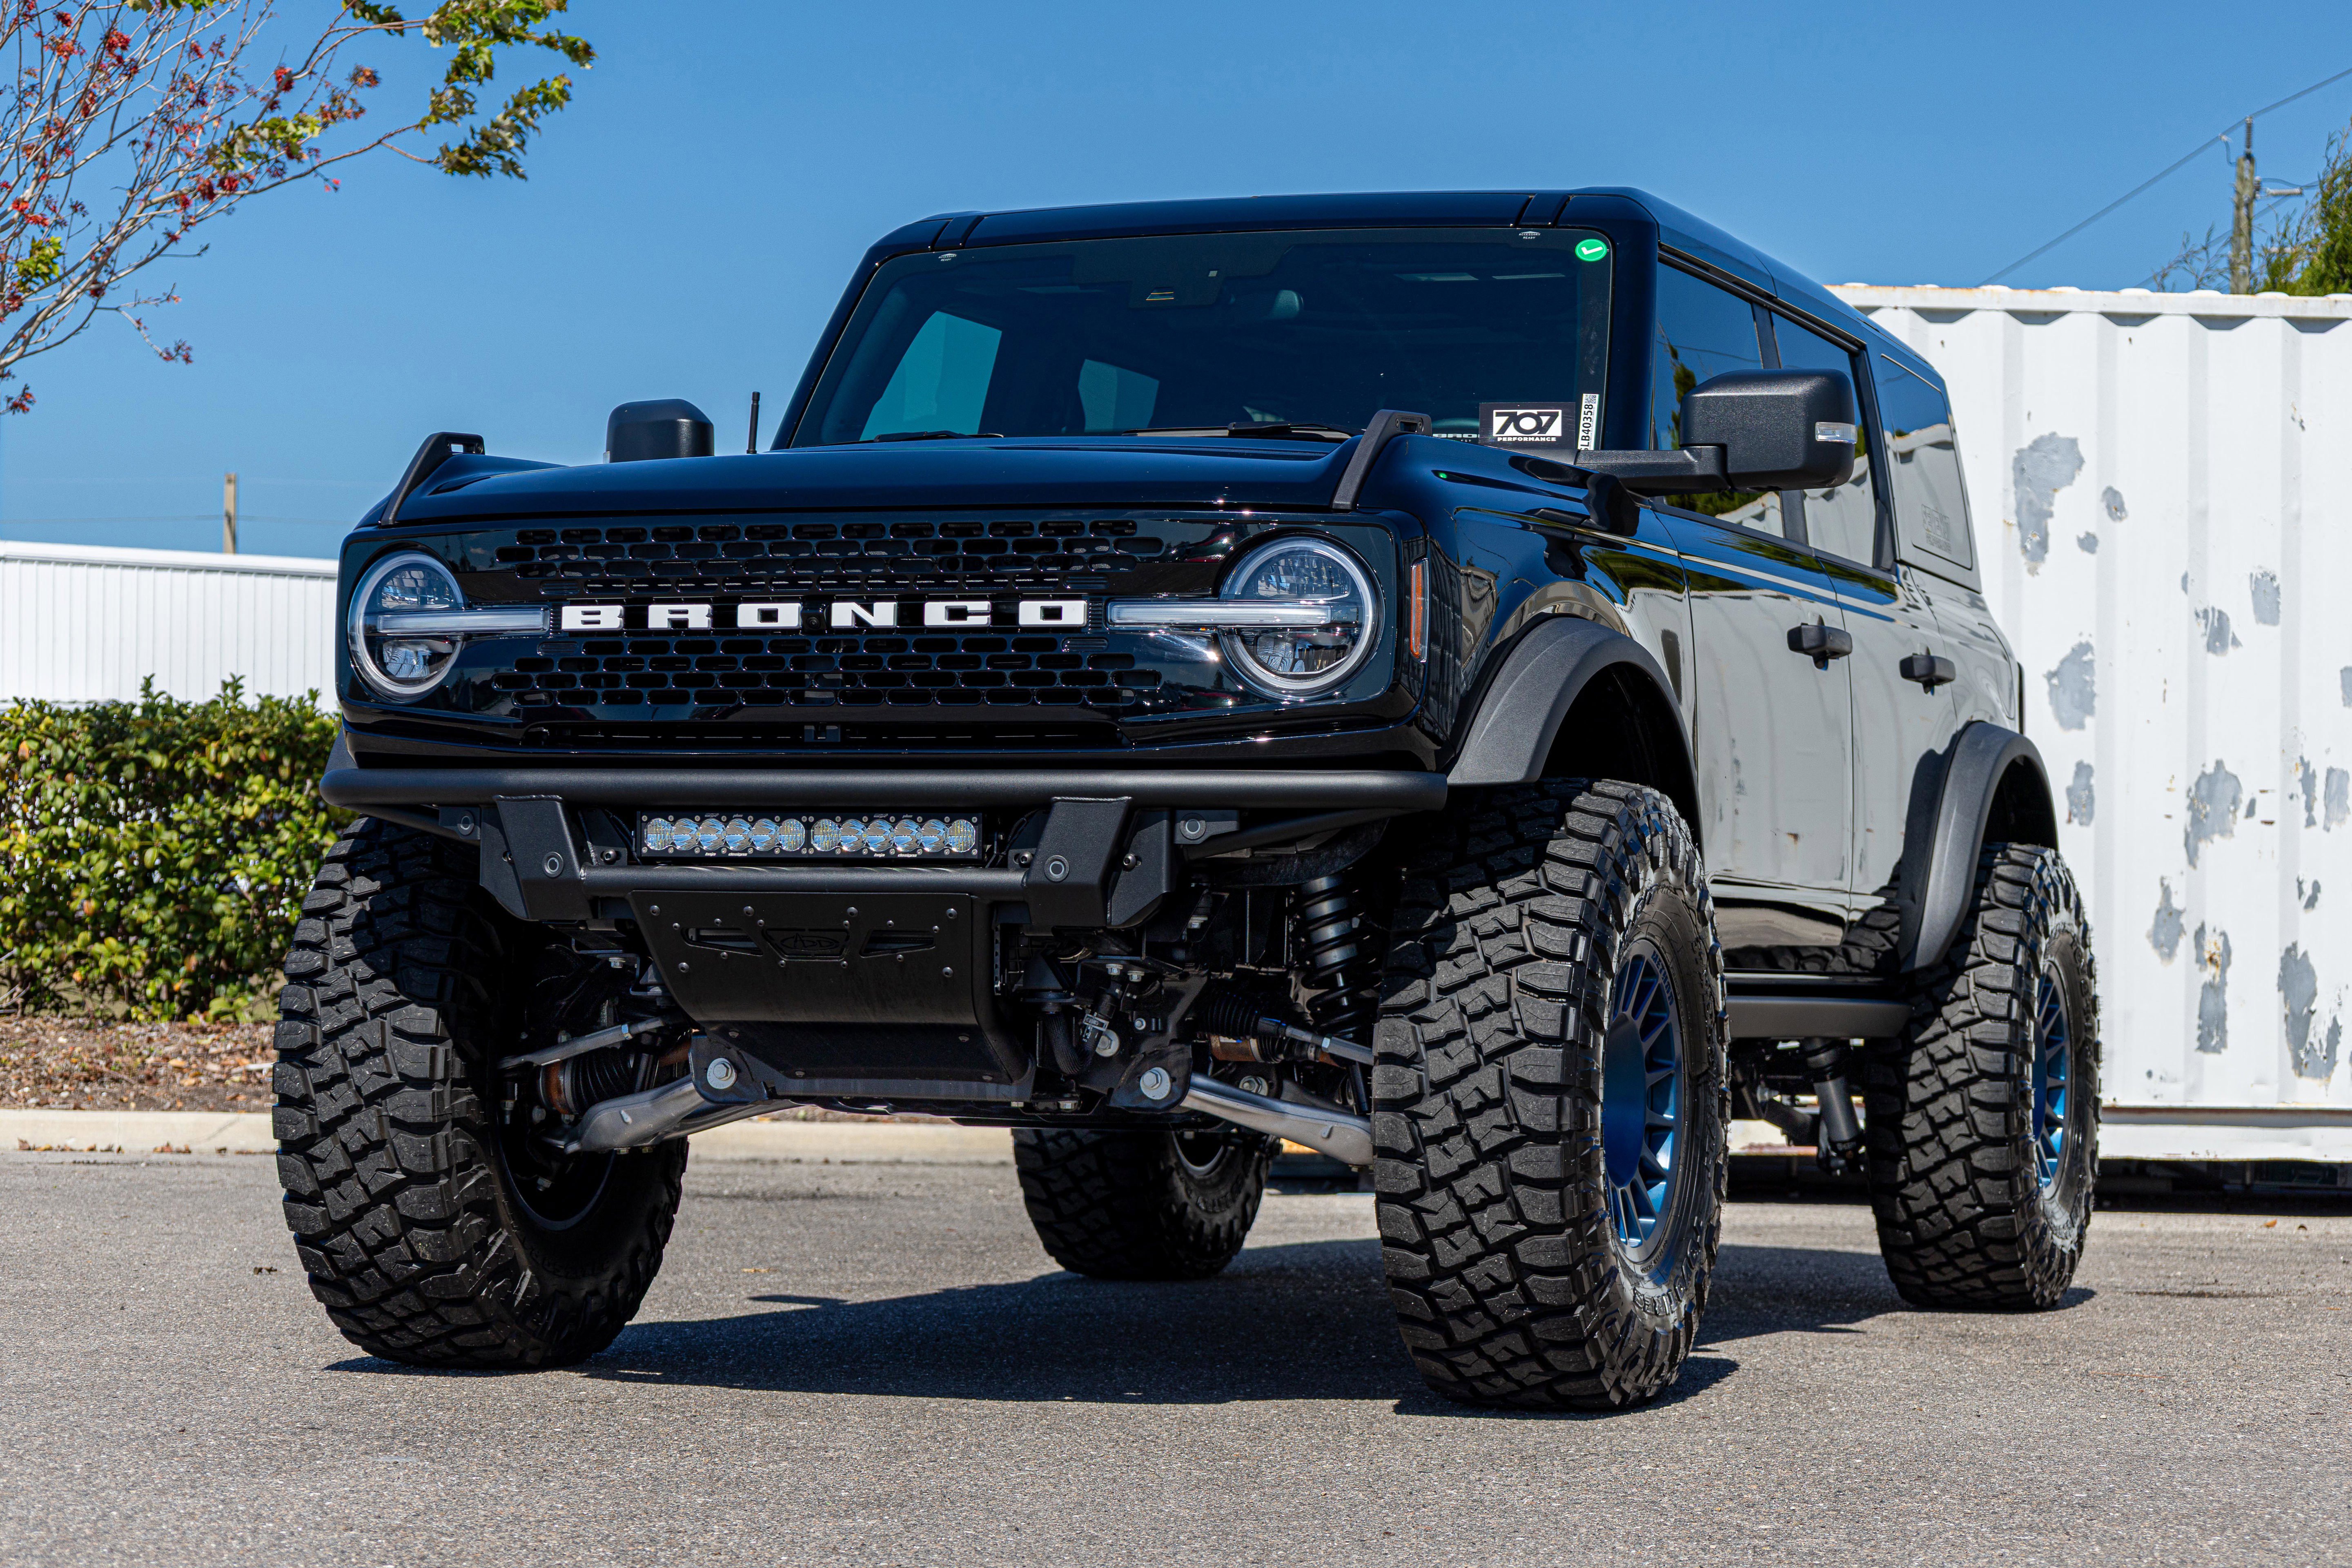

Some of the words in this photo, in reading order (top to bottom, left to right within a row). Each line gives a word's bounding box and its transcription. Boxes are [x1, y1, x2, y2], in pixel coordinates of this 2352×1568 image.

[1495, 411, 1559, 435] 707
[561, 600, 1087, 631] BRONCO
[1651, 950, 1675, 1006] METHOD
[1633, 1287, 1678, 1316] TIRES
